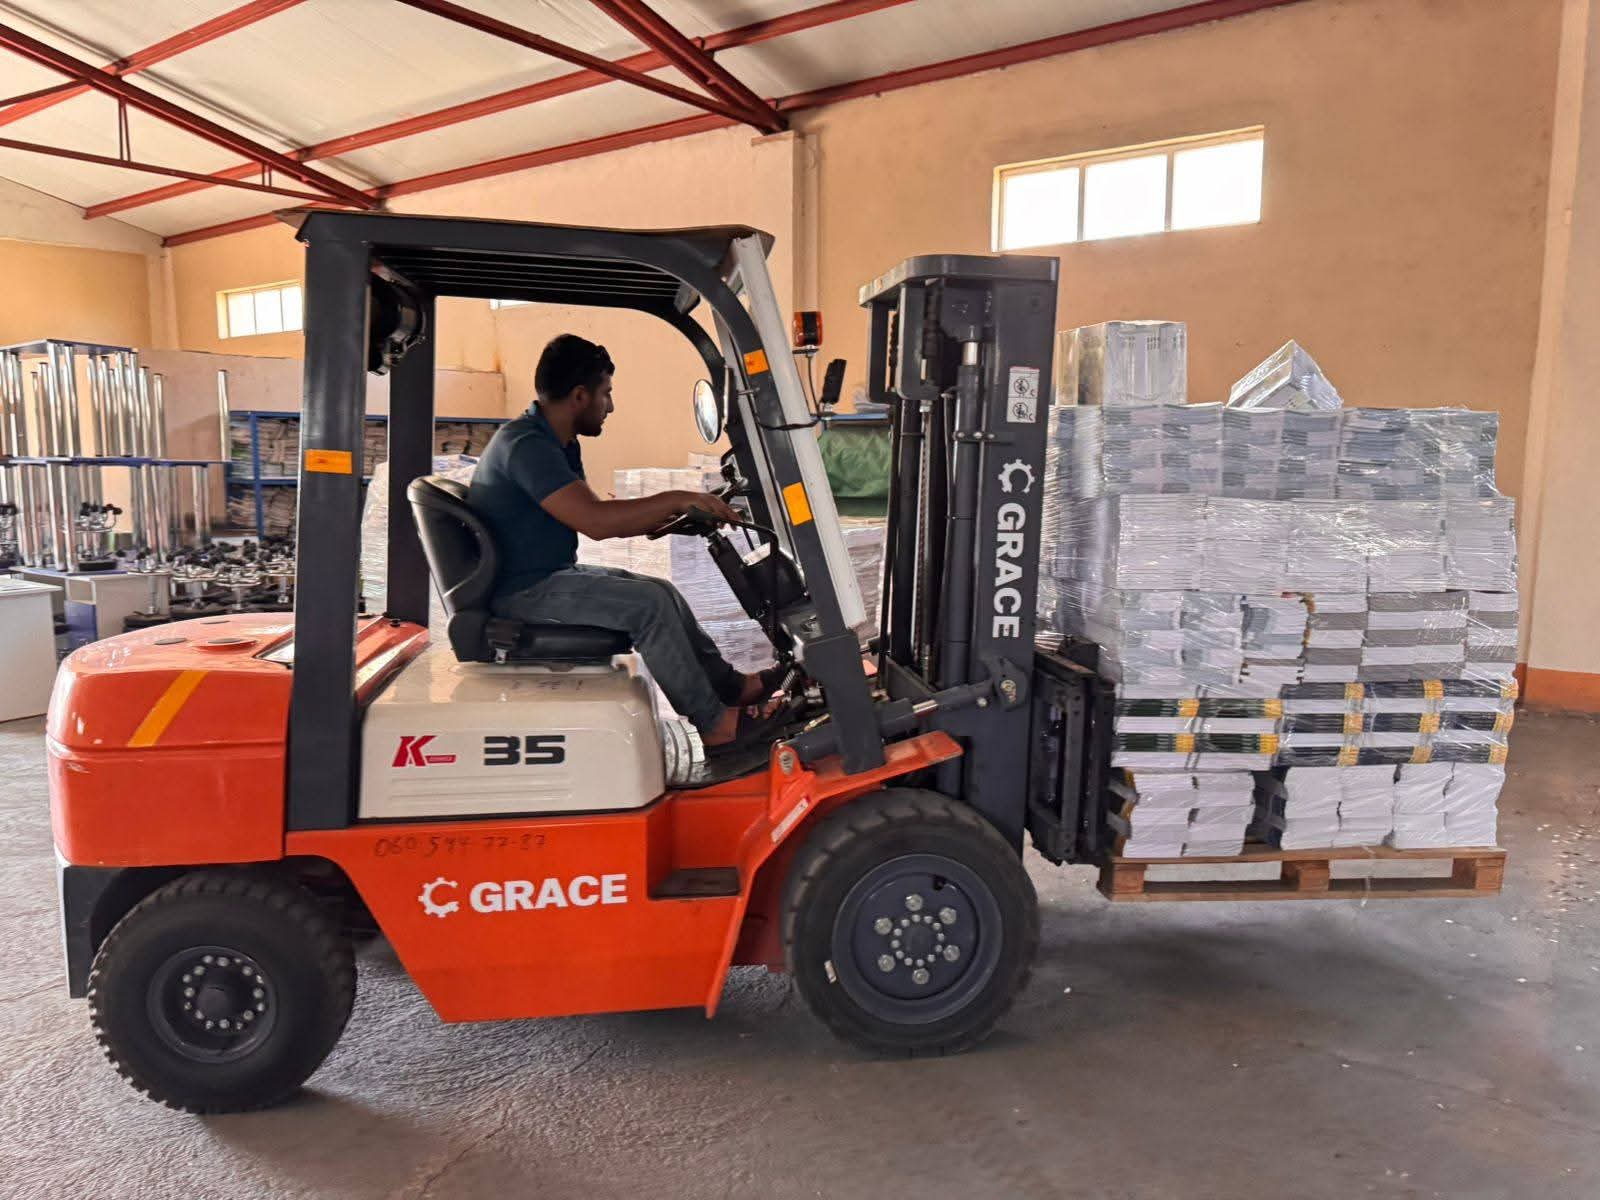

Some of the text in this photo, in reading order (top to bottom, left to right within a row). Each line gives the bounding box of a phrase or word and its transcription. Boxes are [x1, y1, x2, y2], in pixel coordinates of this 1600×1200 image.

[992, 502, 1026, 638] GRACE
[484, 735, 565, 766] 35
[470, 873, 628, 914] GRACE
